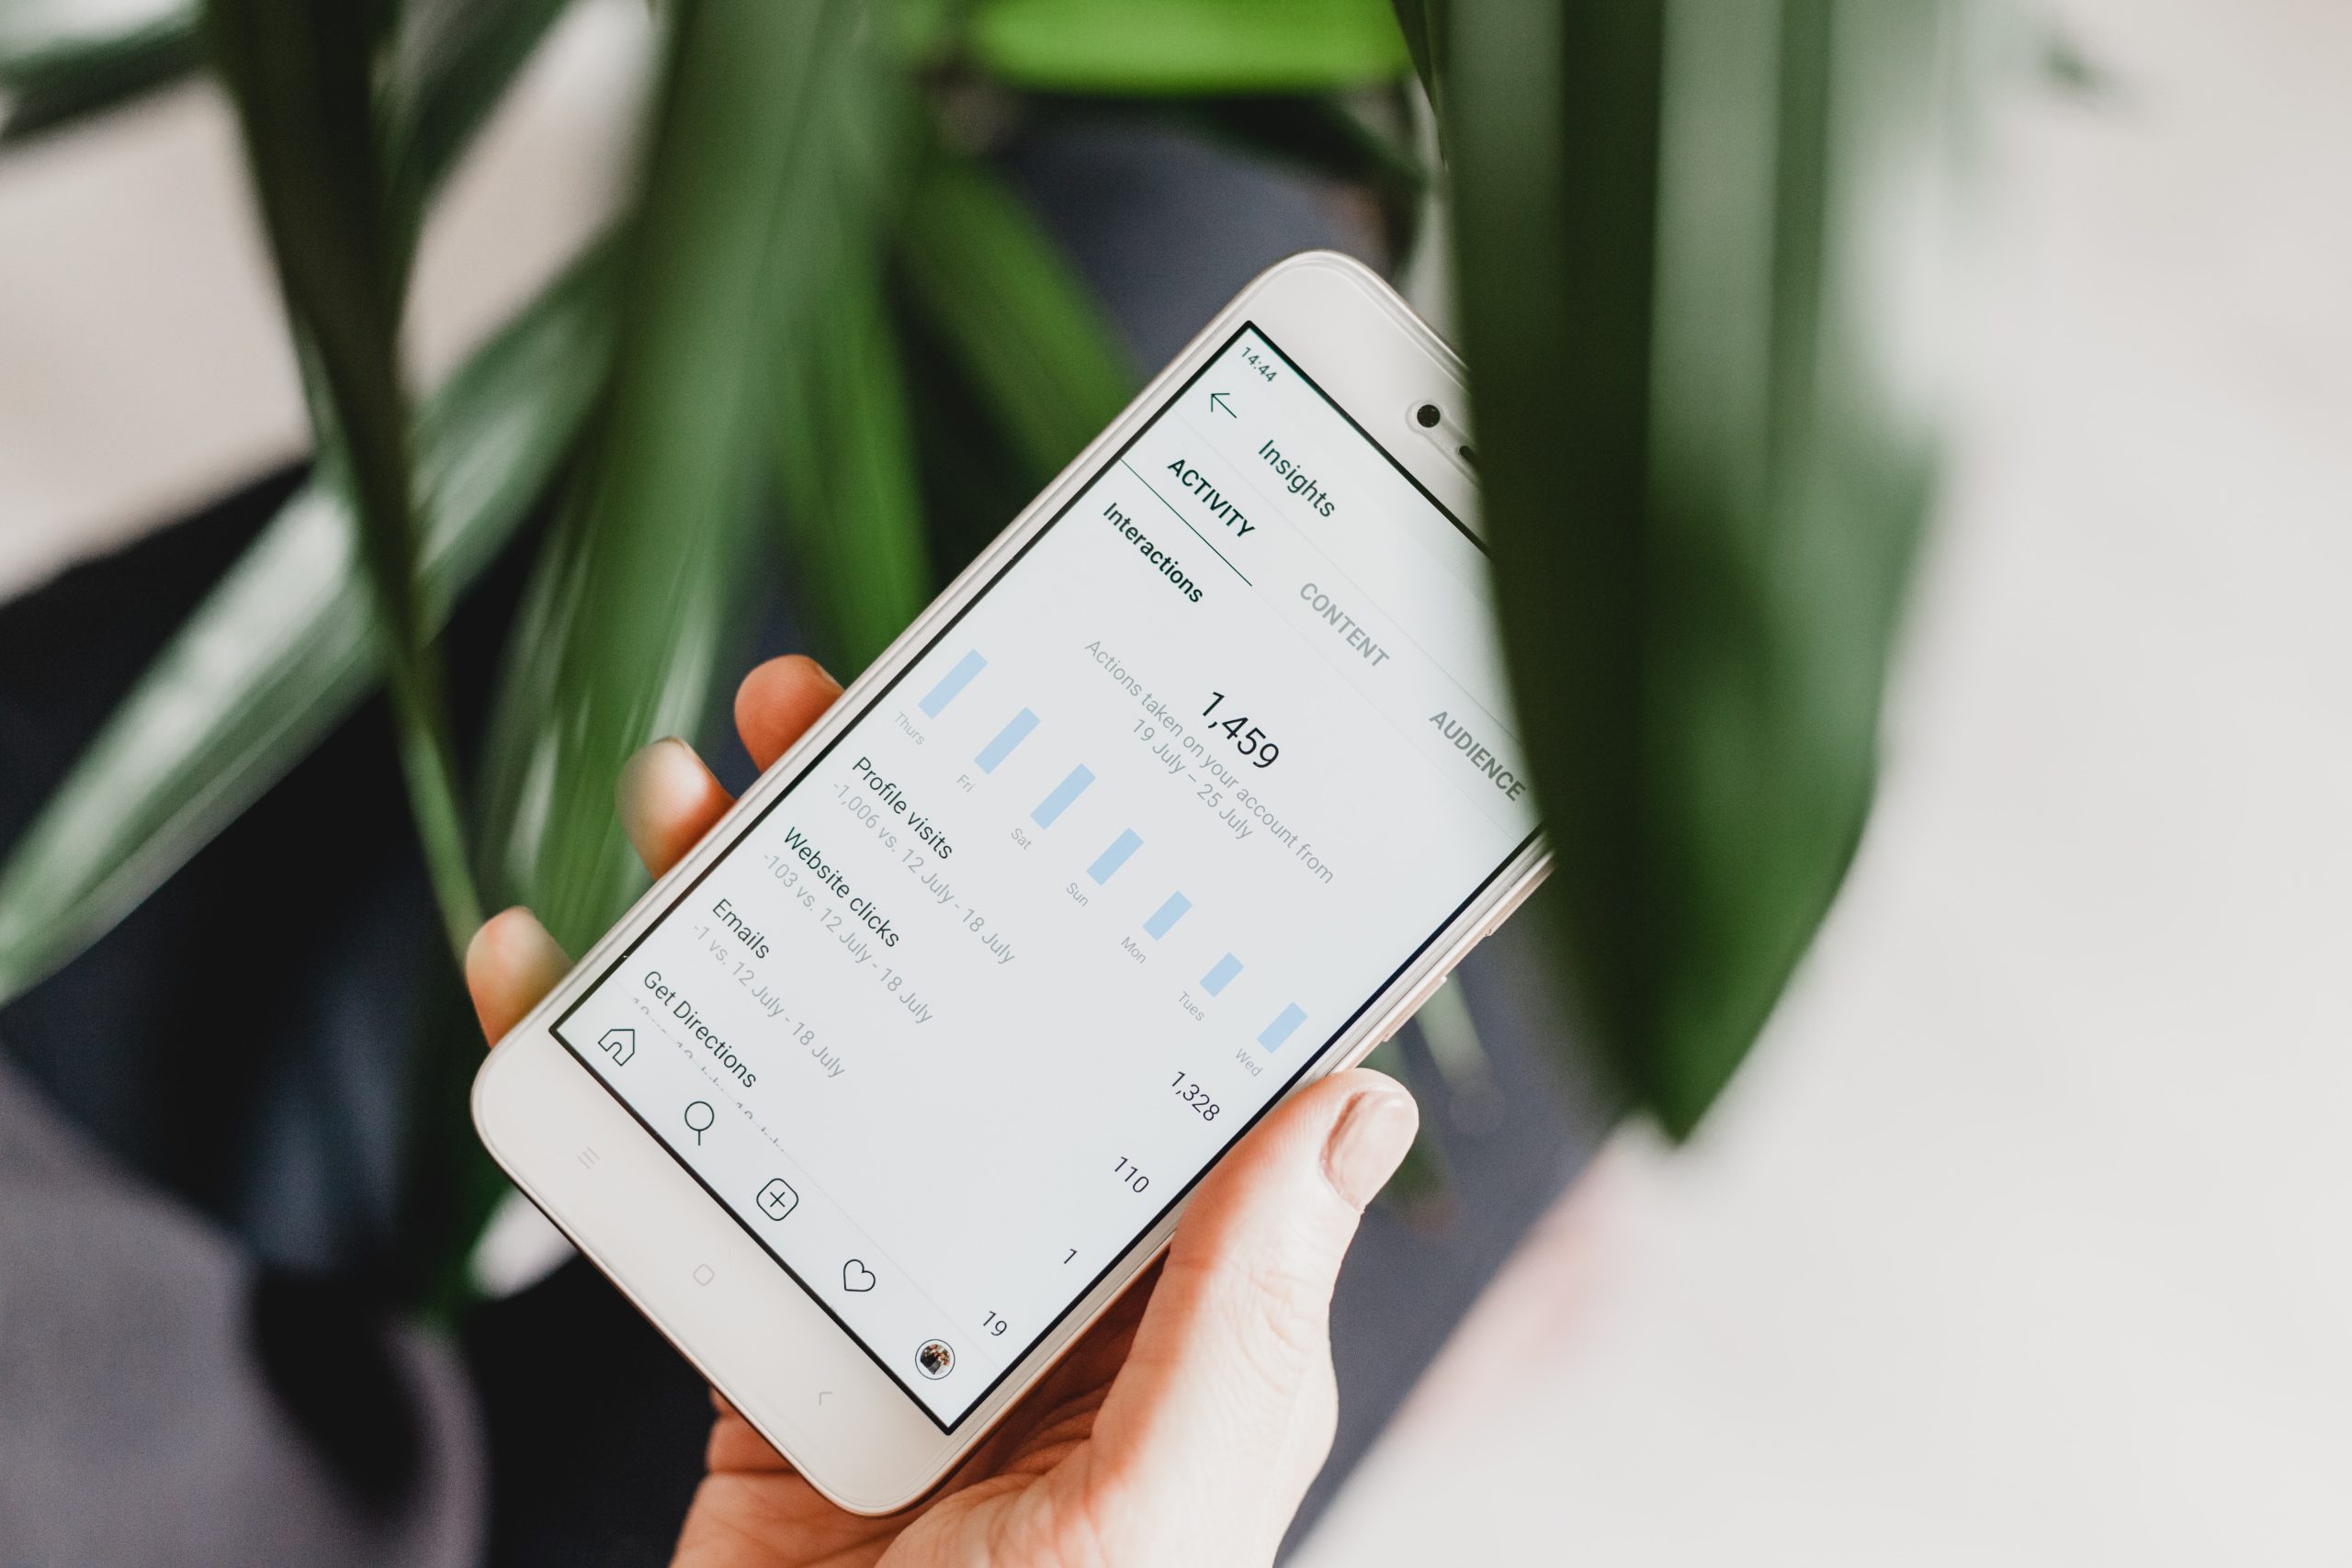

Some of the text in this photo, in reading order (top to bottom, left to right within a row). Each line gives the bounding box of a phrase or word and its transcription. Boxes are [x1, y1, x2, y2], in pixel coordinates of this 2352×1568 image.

[1241, 346, 1278, 382] 14:44
[1258, 439, 1335, 518] Insights
[1102, 502, 1204, 603] Interactions
[1167, 458, 1527, 802] ACTIVITY CONTENT AUDIENCE
[1084, 640, 1334, 885] Actions taken on your account from
[1133, 718, 1156, 741] 19
[1152, 742, 1187, 774] July
[1196, 783, 1224, 808] 25
[1218, 807, 1253, 840] July
[1202, 691, 1280, 769] 1,459
[852, 756, 953, 860] Profile visits
[784, 826, 899, 948] Website clicks
[833, 784, 880, 829] -1,006
[877, 826, 898, 852] vs.
[901, 848, 925, 874] 12
[920, 873, 955, 905] July
[962, 908, 985, 933] 18
[981, 932, 1016, 964] July
[895, 710, 1264, 1077] Thurs Fri Sat Sun Mon Tues Wed
[712, 897, 770, 959] Emails
[763, 854, 798, 888] -103
[796, 886, 816, 912] vs.
[820, 908, 842, 933] 12
[838, 931, 873, 964] July
[879, 967, 903, 992] 18
[899, 992, 933, 1024] July
[644, 971, 757, 1089] Get Directions
[694, 926, 710, 941] -1
[708, 940, 729, 965] vs.
[732, 961, 755, 987] 12
[751, 986, 786, 1018] July
[792, 1021, 815, 1046] 18
[811, 1045, 845, 1078] July
[1171, 1071, 1220, 1122] 1,328
[1114, 1156, 1149, 1193] 110
[1063, 1248, 1078, 1265] 1
[982, 1310, 1008, 1337] 19
